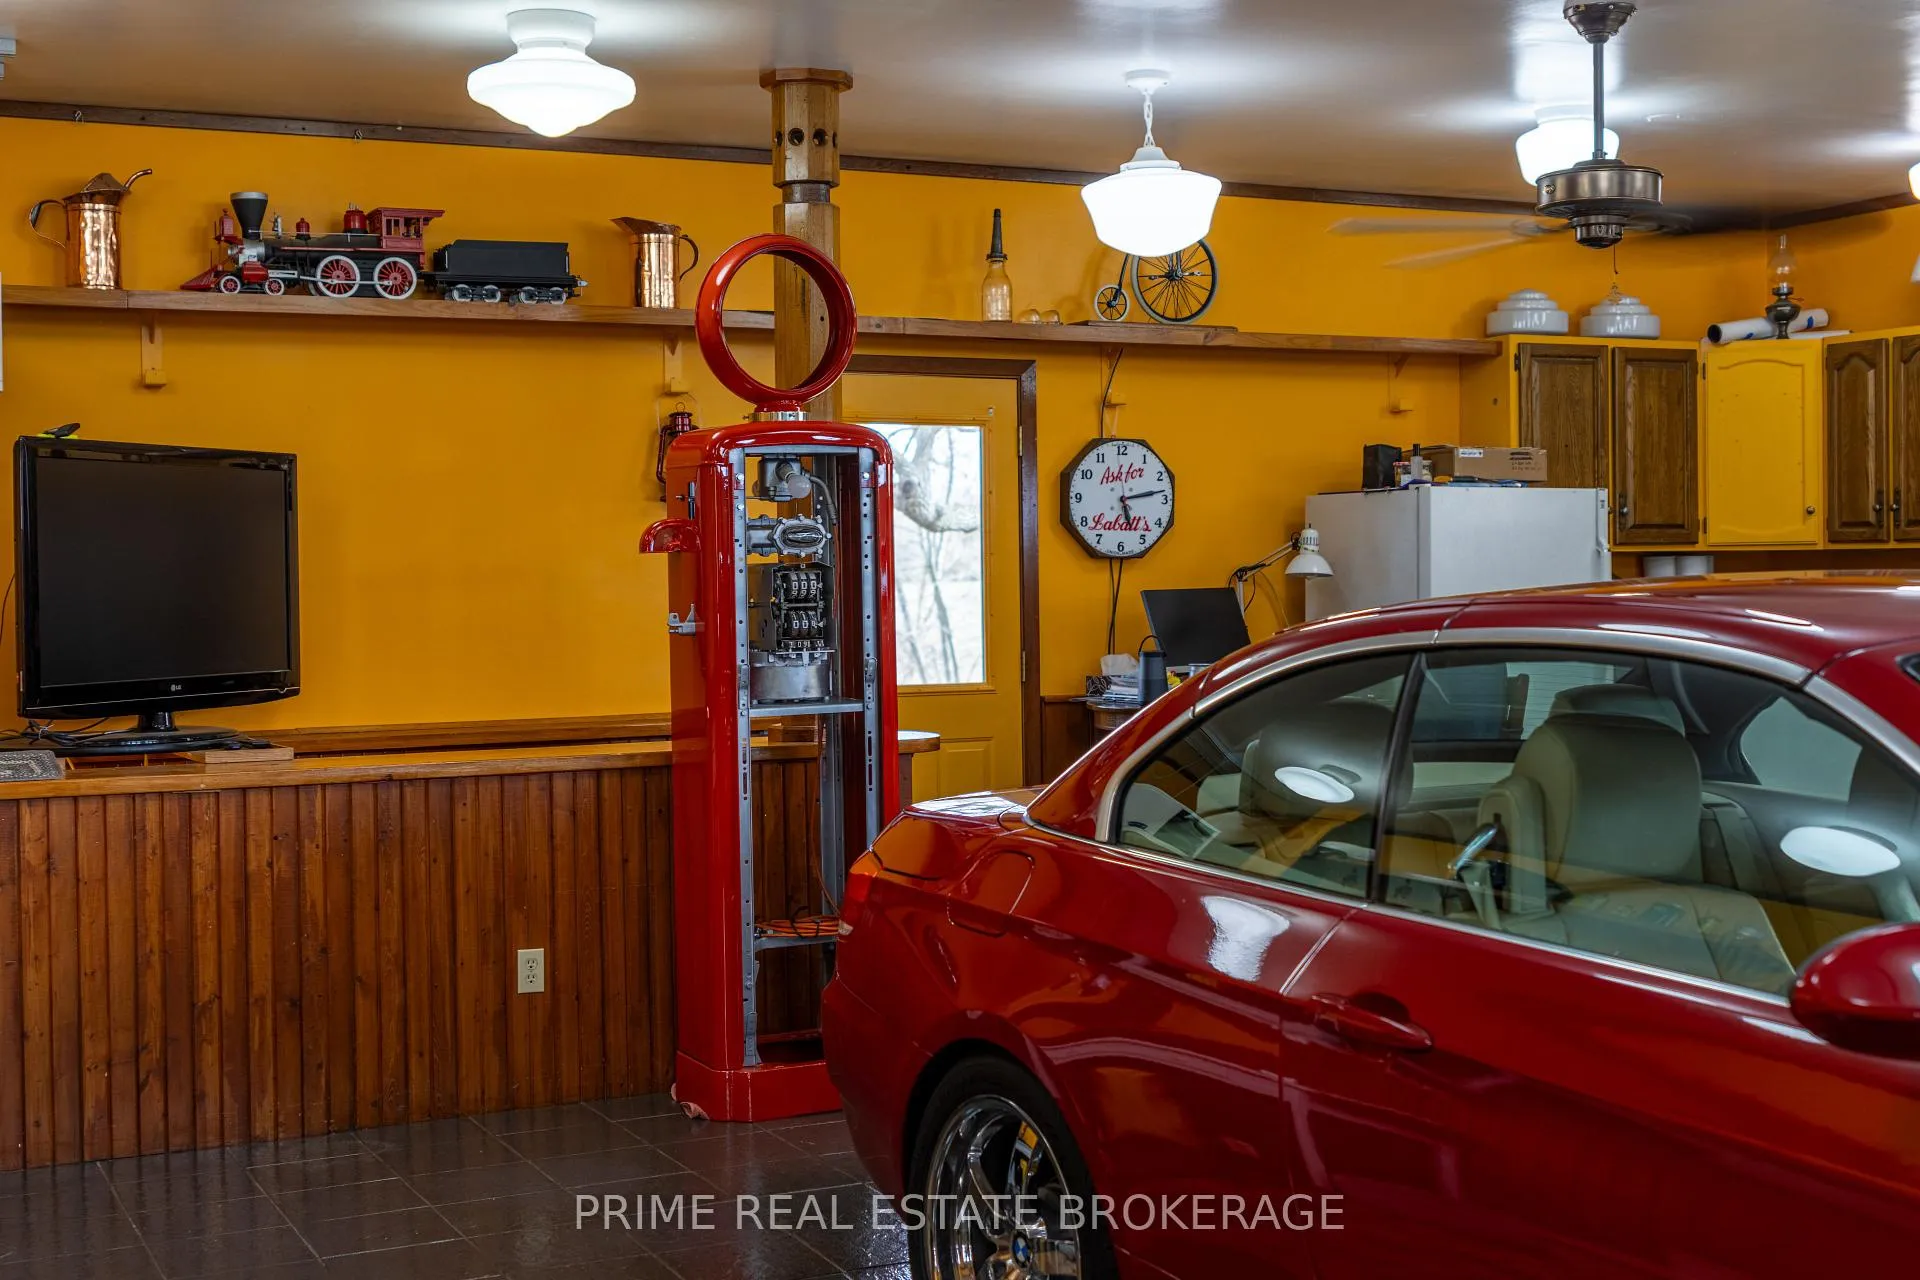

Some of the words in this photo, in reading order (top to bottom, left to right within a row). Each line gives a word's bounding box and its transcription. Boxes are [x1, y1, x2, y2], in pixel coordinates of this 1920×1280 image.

[1117, 445, 1128, 456] 12
[1096, 452, 1105, 463] 11
[1142, 454, 1147, 464] 1
[1081, 469, 1093, 480] 10
[1100, 463, 1123, 485] Ask
[1124, 462, 1145, 483] for
[1156, 471, 1164, 482] 2
[1074, 492, 1082, 503] 9
[1161, 494, 1168, 505] 3
[1080, 516, 1088, 527] 8
[1088, 512, 1152, 532] Labatt's
[1154, 517, 1163, 528] 4
[1095, 533, 1103, 545] 7
[1139, 534, 1146, 545] 5
[1117, 542, 1125, 552] 6
